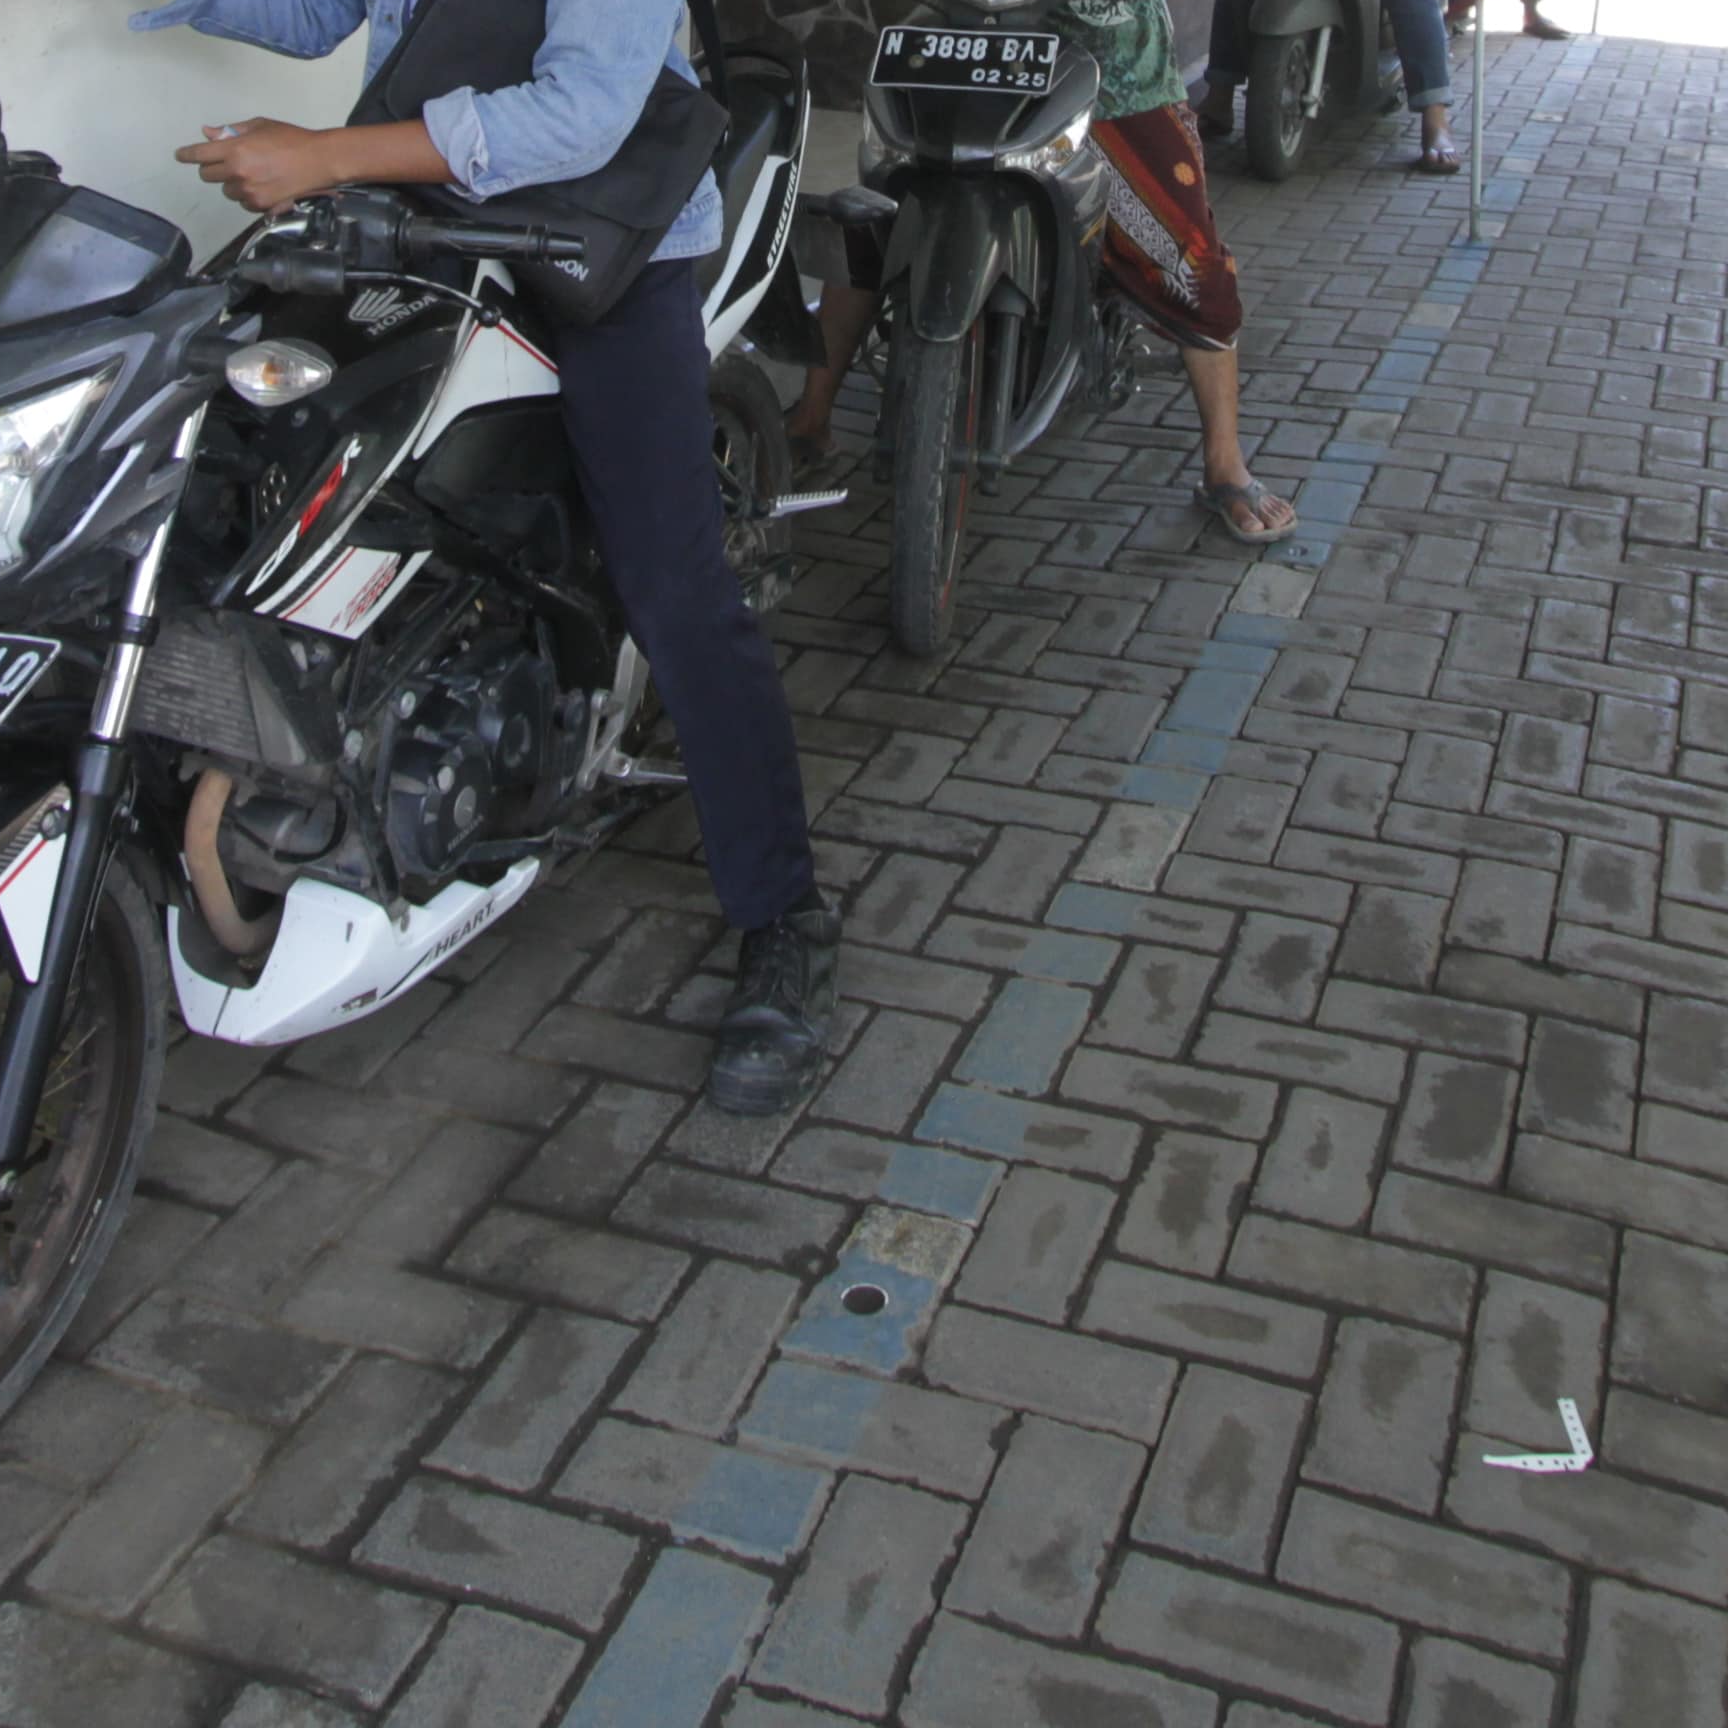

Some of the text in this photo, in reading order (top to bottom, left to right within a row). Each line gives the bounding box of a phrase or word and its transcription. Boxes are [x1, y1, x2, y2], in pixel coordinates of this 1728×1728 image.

[884, 31, 1058, 64] N 3898 BAJ
[367, 292, 439, 336] HONDA
